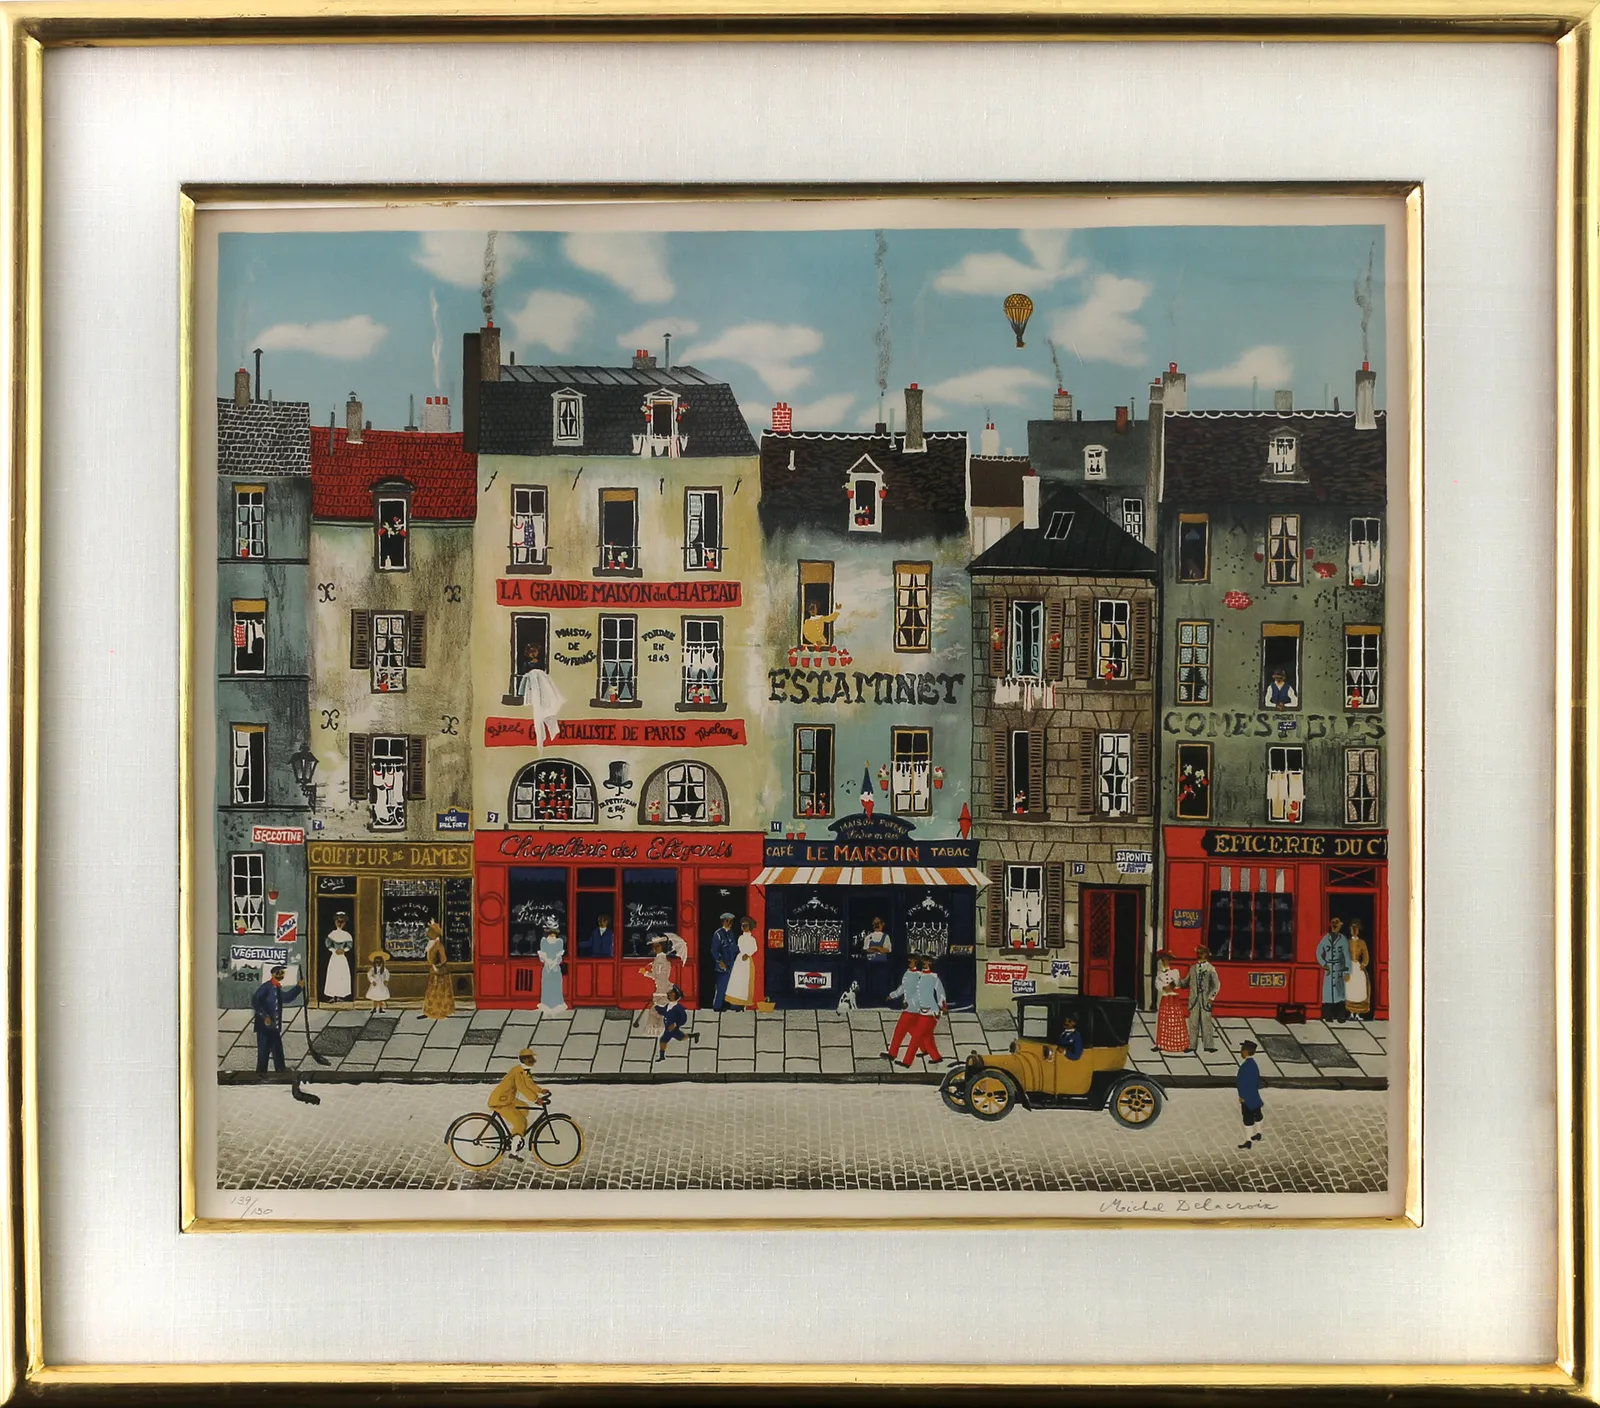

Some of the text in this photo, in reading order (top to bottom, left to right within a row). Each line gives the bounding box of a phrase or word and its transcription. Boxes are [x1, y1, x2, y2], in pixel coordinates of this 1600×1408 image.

[500, 581, 740, 603] LA GRANDE MAISON du CHAPEAU
[568, 642, 580, 650] DE
[768, 667, 966, 705] ESTAMINET
[622, 726, 639, 740] DE
[644, 725, 686, 741] PARIS
[489, 813, 496, 822] 9
[254, 830, 301, 841] SECCOTINE
[500, 835, 608, 861] Chapellerie
[611, 841, 638, 859] des
[1215, 835, 1387, 855] EPICERIE DU C
[310, 846, 391, 866] COIFFEUR
[410, 847, 469, 866] DAMES
[806, 846, 828, 861] LE
[833, 845, 920, 862] MARSOIN
[930, 847, 970, 857] TABAC
[1116, 852, 1152, 862] SAPONITE
[233, 948, 287, 960] VEGETALINE
[797, 974, 827, 985] MARTINI
[1250, 974, 1286, 986] LIEBIG
[1100, 1198, 1279, 1213] Michel Delacroix
